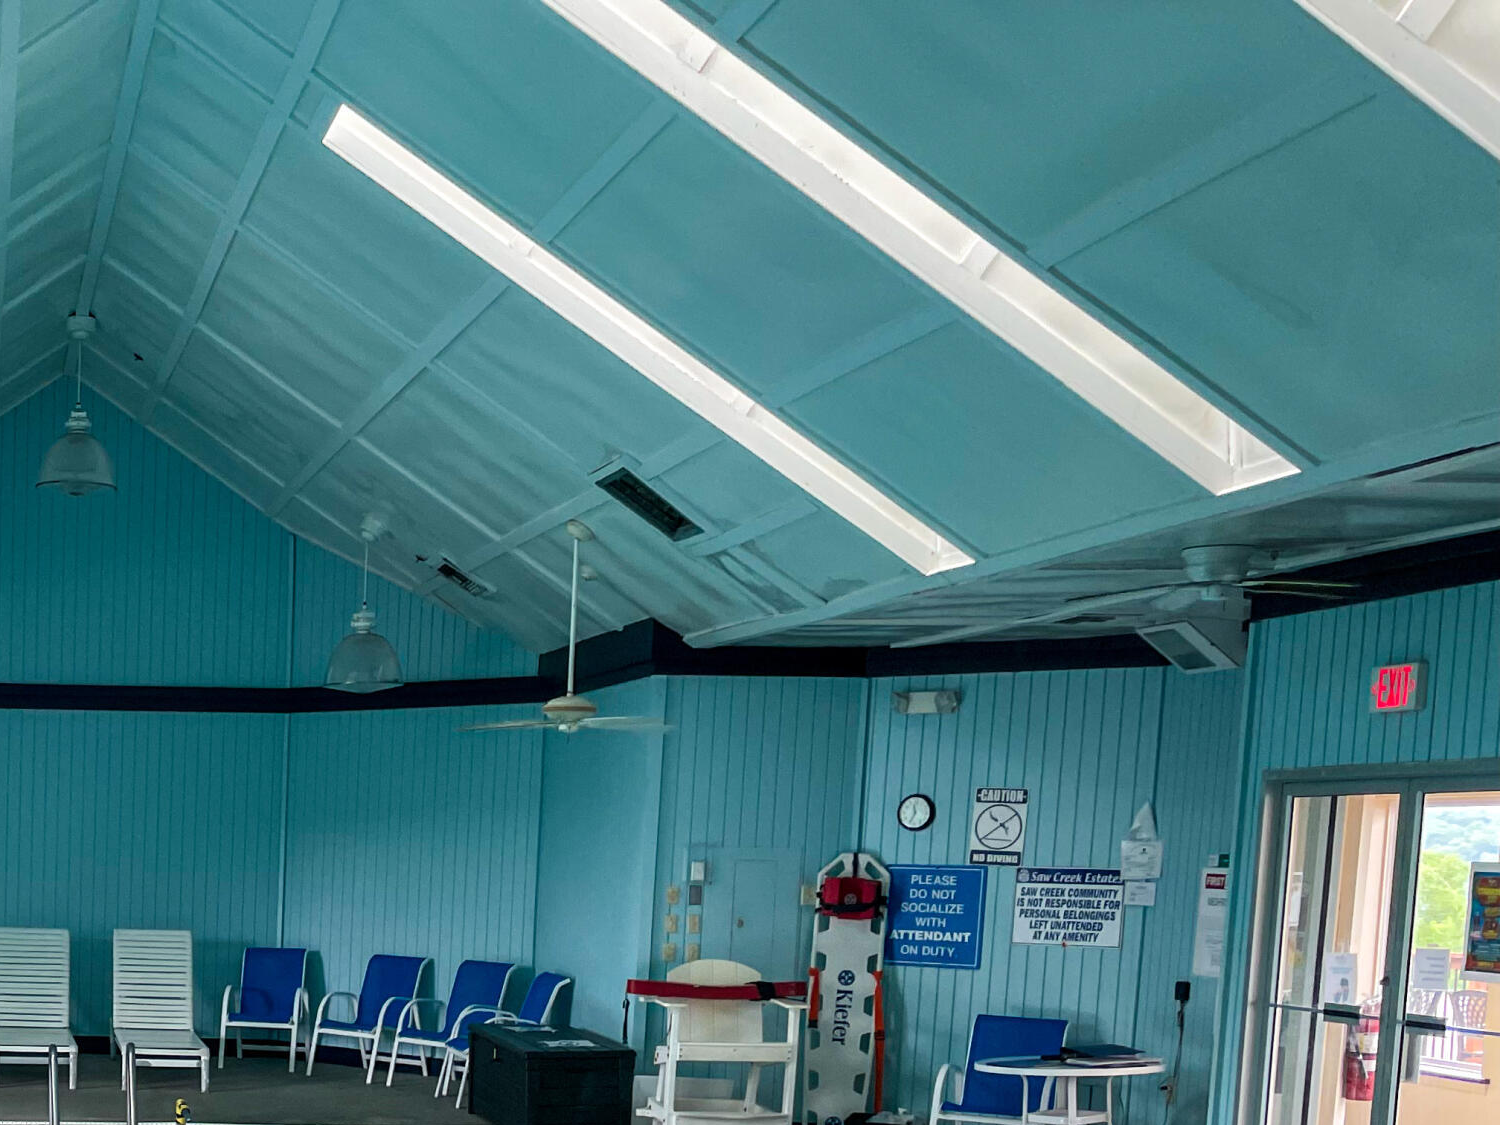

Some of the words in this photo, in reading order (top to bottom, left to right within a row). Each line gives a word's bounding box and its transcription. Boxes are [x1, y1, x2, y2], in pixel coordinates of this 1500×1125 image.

[1376, 665, 1412, 709] EXIT
[972, 854, 985, 862] NO
[986, 854, 1018, 863] DIVING
[910, 874, 957, 886] PLEASE
[1031, 871, 1052, 882] Saw
[1053, 872, 1082, 883] Creek
[909, 888, 927, 899] DO
[931, 889, 956, 900] NOT
[1020, 887, 1038, 896] SAW
[1040, 887, 1066, 897] CREEK
[1068, 888, 1119, 899] COMMUNITY
[900, 902, 964, 914] SOCIALIZE
[1017, 898, 1025, 907] IS
[1026, 898, 1043, 907] NOT
[1044, 899, 1100, 909] RESPONSIBLE
[1103, 900, 1120, 910] FOR
[1019, 909, 1061, 919] PERSONAL
[1063, 910, 1116, 921] BELONGINGS
[915, 916, 946, 928] WITH
[1029, 920, 1048, 929] LEFT
[1050, 920, 1103, 931] UNATTENDED
[890, 929, 971, 942] ATTENDANT
[1032, 931, 1043, 940] AT
[1044, 932, 1060, 941] ANY
[1062, 932, 1099, 942] AMENITY
[900, 944, 918, 955] ON
[922, 945, 955, 957] DUTY
[831, 988, 853, 1046] Kiefer
